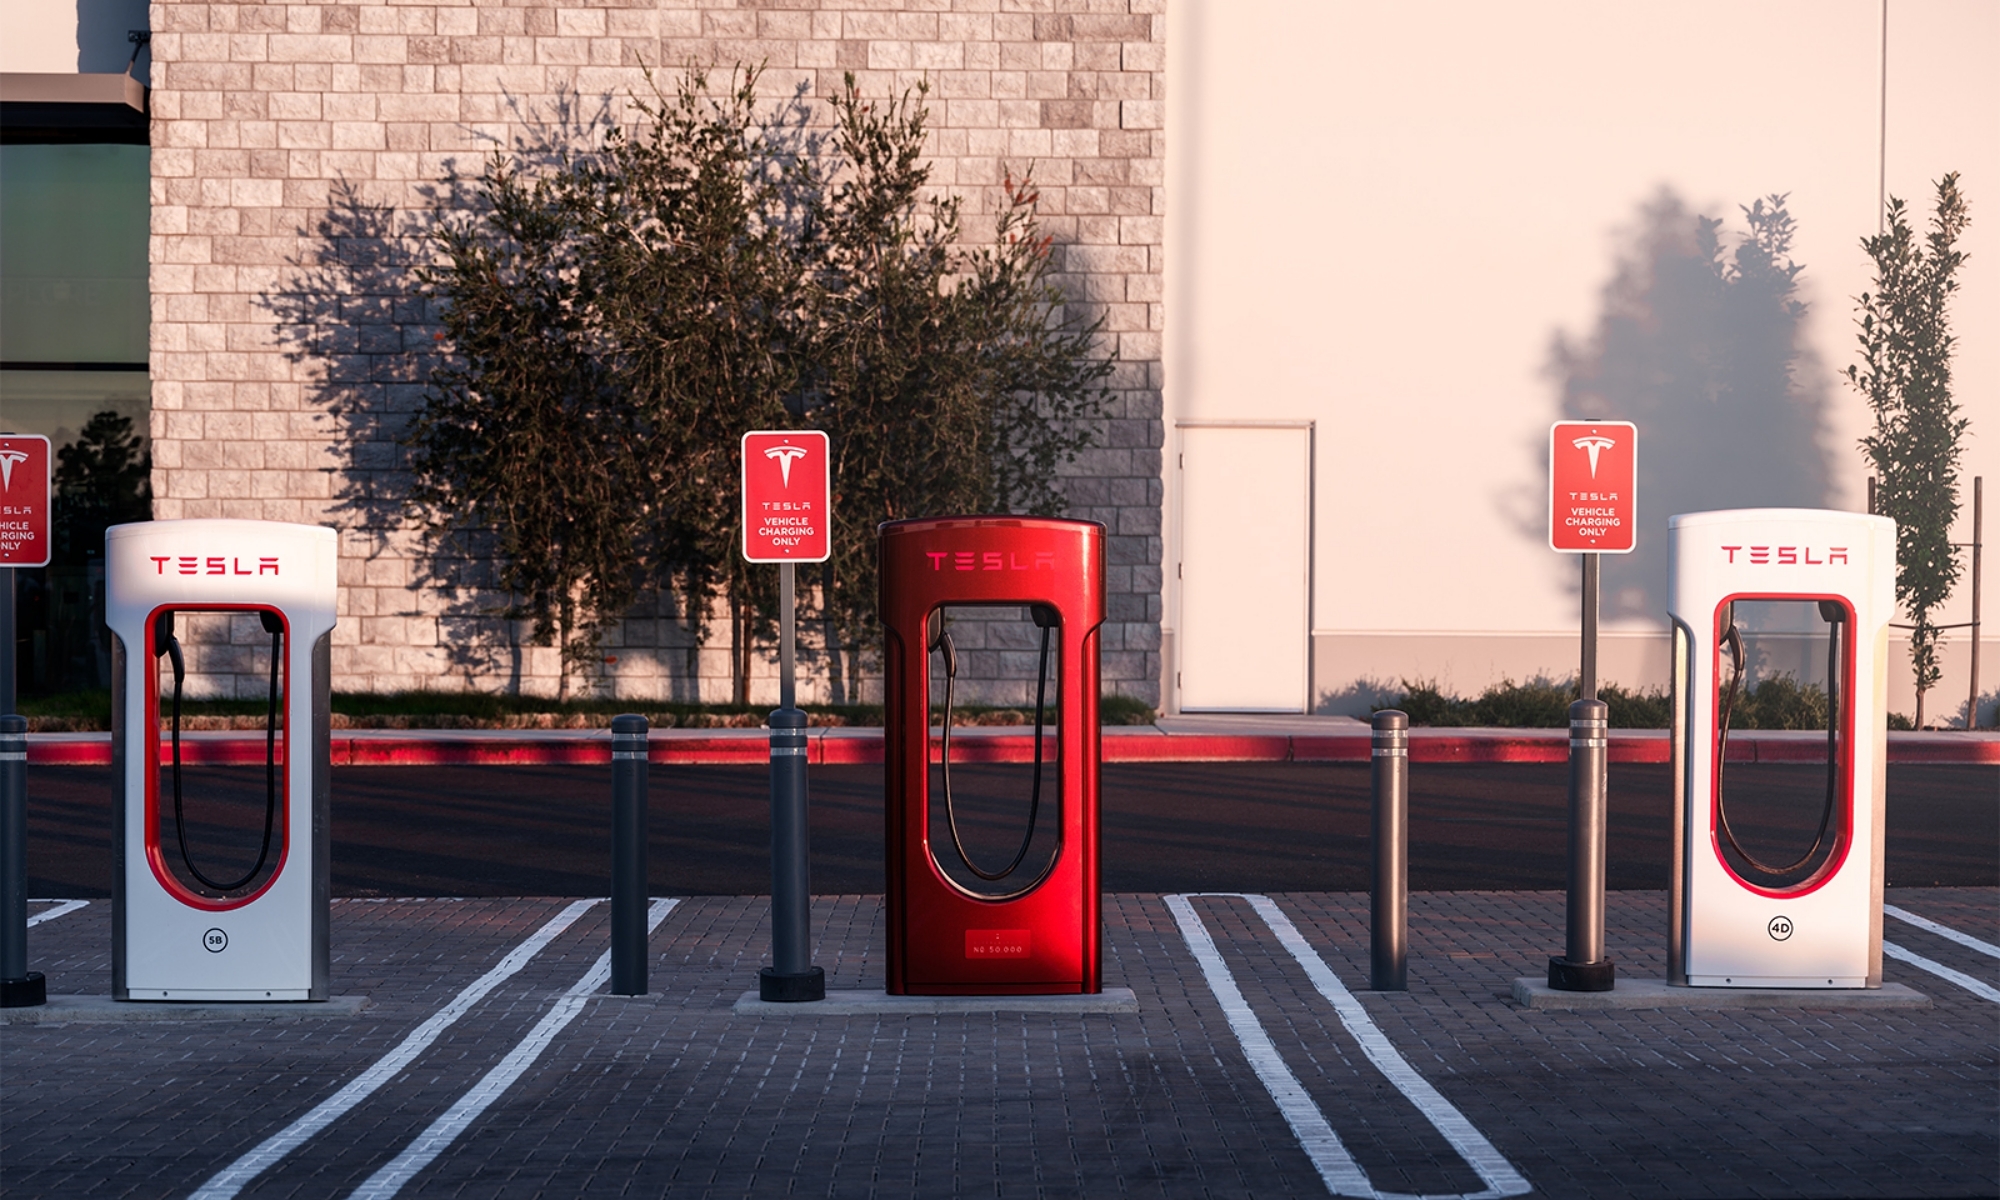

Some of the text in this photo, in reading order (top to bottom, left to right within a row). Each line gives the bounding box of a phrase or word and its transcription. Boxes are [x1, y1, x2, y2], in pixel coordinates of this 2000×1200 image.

[1569, 492, 1618, 501] TESLA
[0, 506, 32, 515] SLA
[762, 502, 811, 511] TESLA
[1570, 508, 1615, 516] VEHICLE
[764, 517, 809, 526] VEHICLE
[1565, 517, 1621, 526] CHARGING
[0, 531, 35, 541] RGING
[758, 527, 815, 536] CHARGING
[1578, 528, 1607, 536] ONLY
[0, 541, 21, 550] NLY
[772, 537, 801, 546] ONLY
[1720, 545, 1849, 565] TESLA
[149, 556, 279, 575] TESLA
[925, 551, 1055, 571] TESLA
[1771, 923, 1790, 933] 4D
[209, 935, 223, 945] 5B
